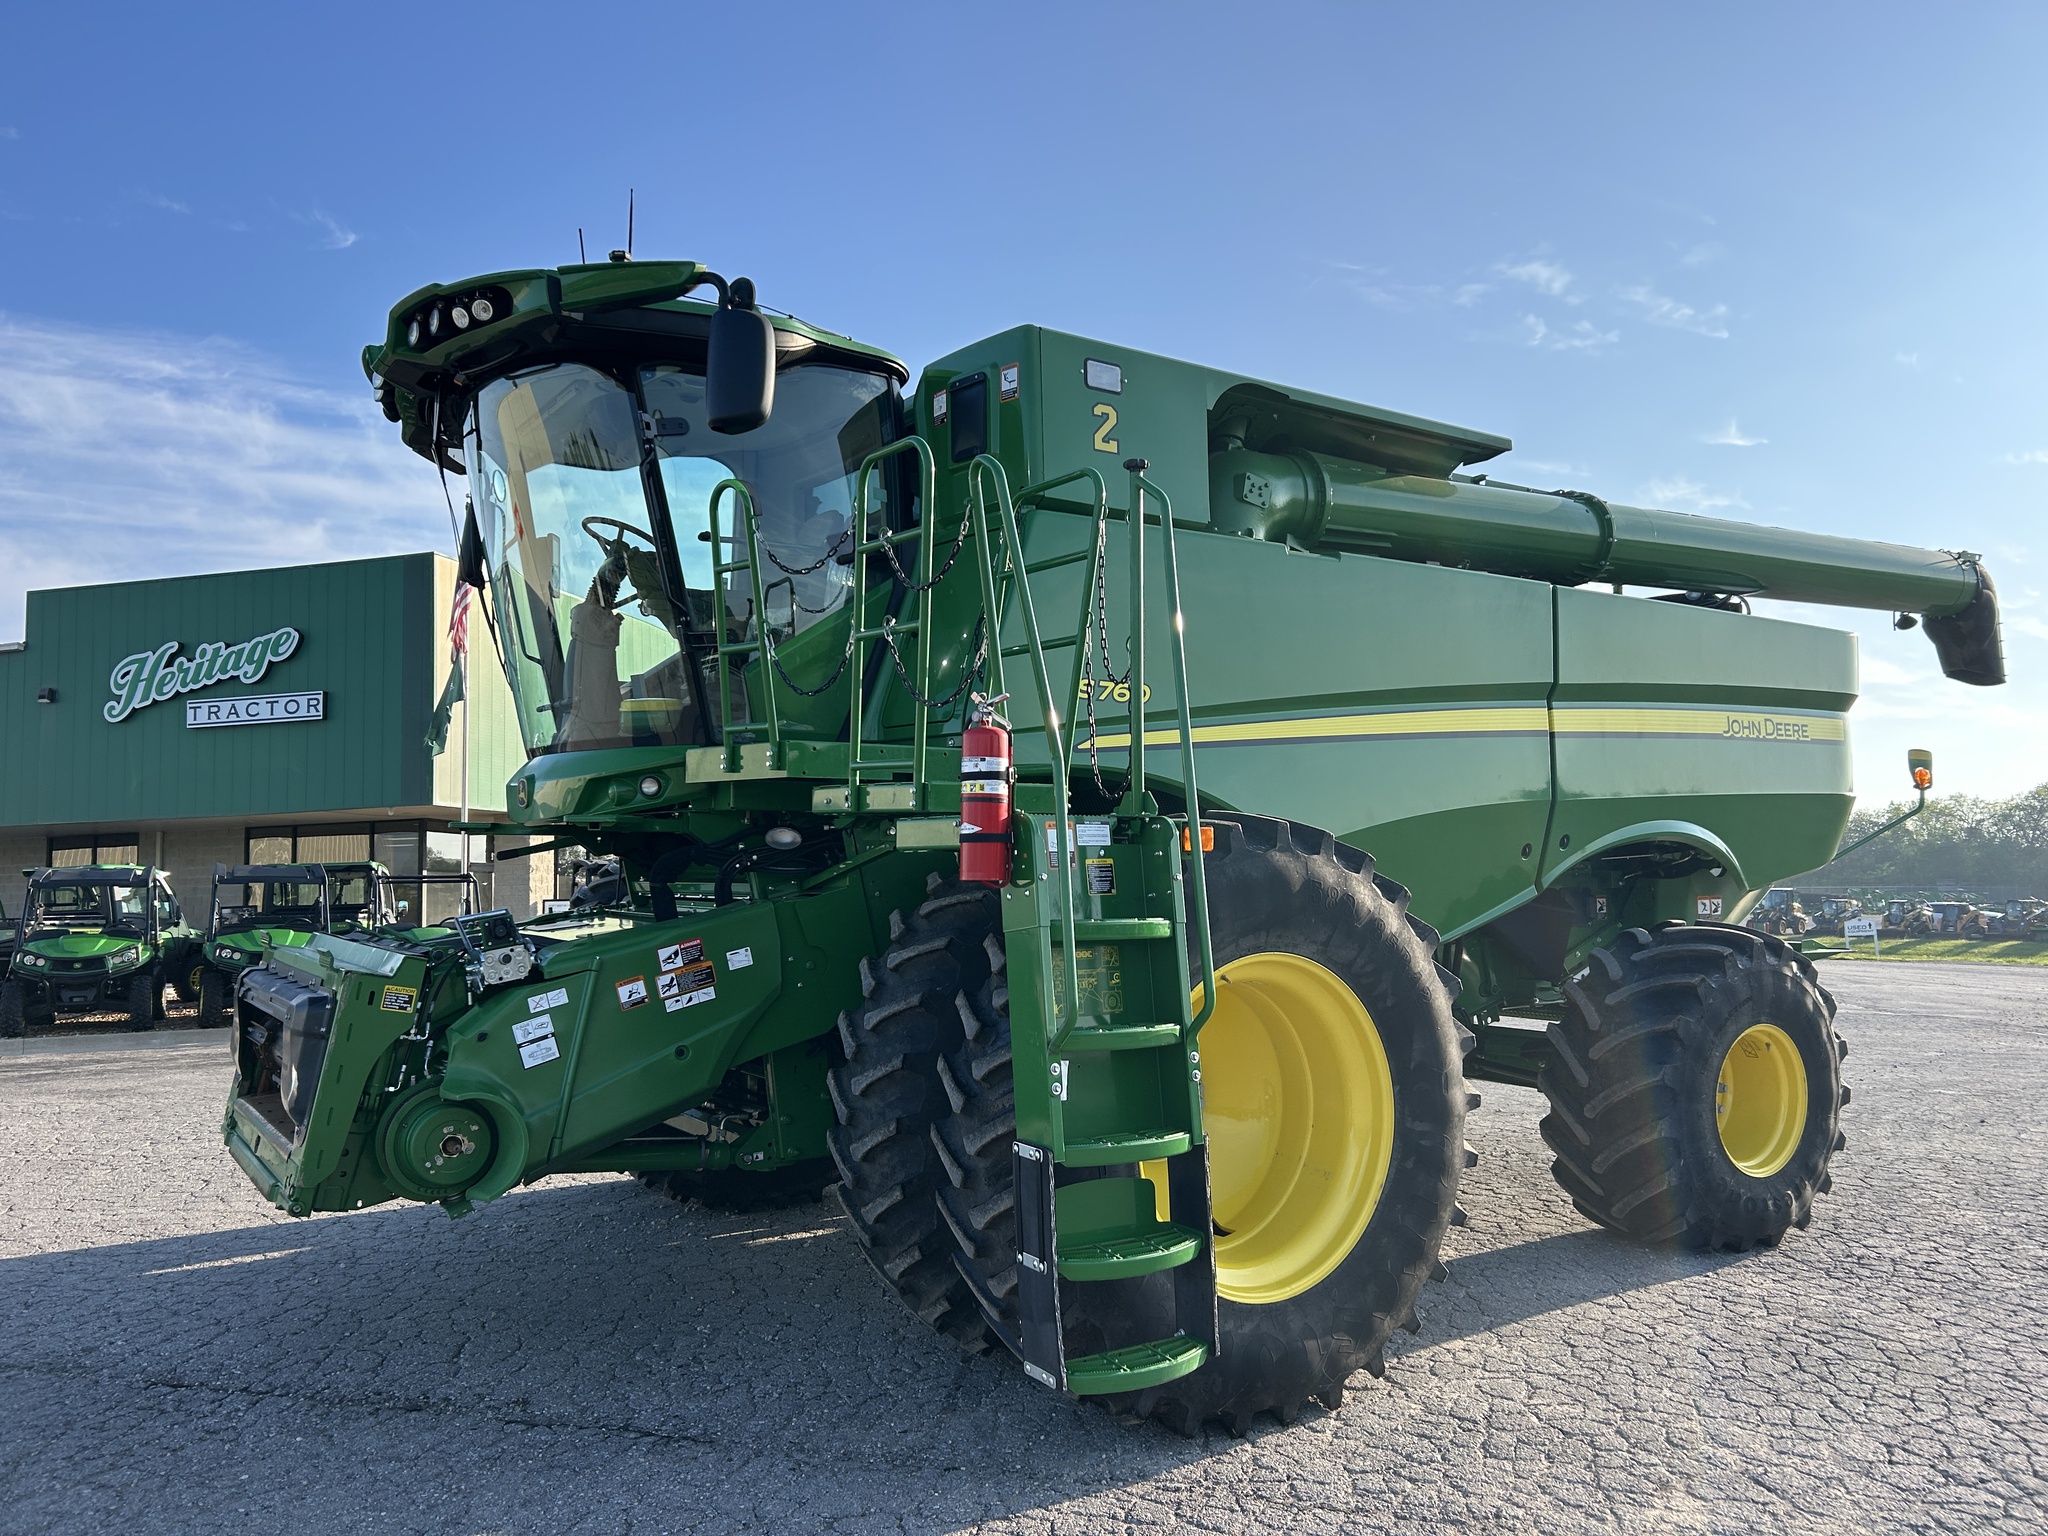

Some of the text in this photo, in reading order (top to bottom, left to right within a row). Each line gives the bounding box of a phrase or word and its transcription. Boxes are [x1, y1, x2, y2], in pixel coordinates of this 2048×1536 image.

[1092, 402, 1119, 454] 2
[104, 627, 299, 722] Heritage
[189, 697, 321, 722] TRACTOR
[1723, 715, 1809, 739] JOHN DEERE
[390, 986, 415, 994] CAUTION
